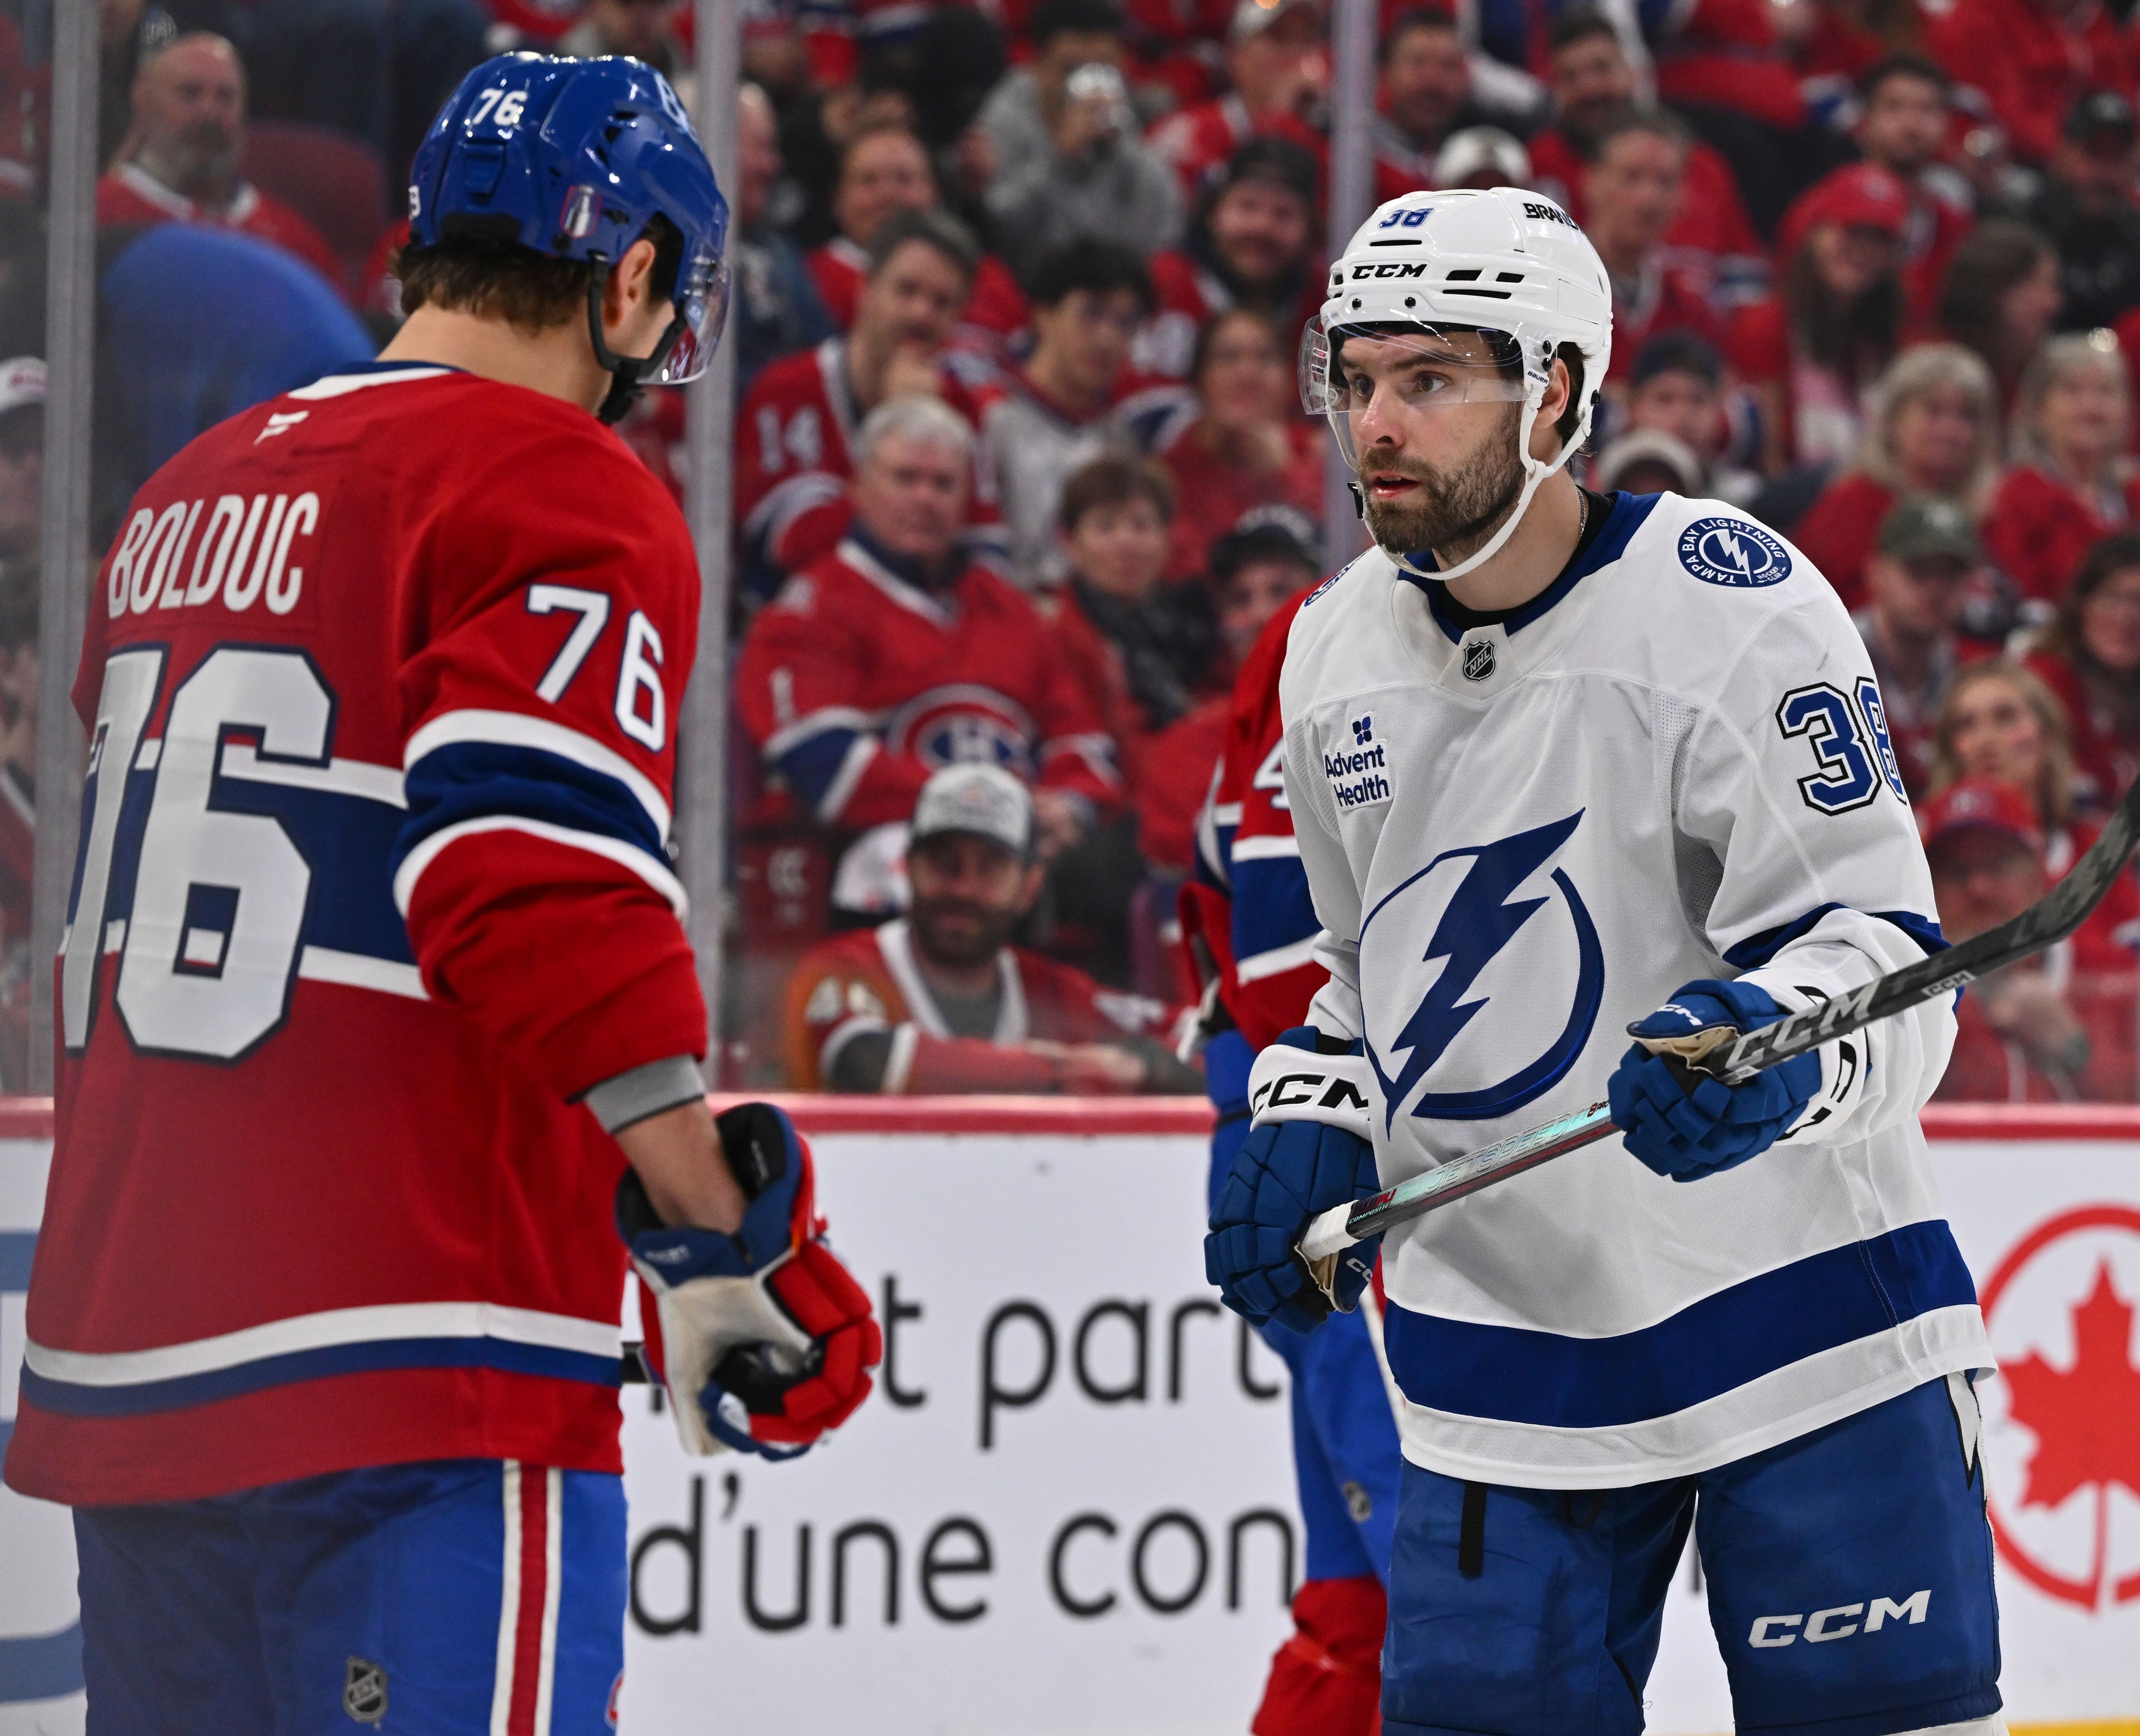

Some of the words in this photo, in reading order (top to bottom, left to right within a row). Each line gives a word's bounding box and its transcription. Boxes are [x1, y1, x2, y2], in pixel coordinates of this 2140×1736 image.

[472, 87, 528, 126] 76
[1378, 208, 1435, 229] 38
[1522, 203, 1584, 234] BRAND
[1352, 264, 1427, 279] CCM
[108, 492, 320, 619] BOLDUC
[1682, 528, 1700, 551] BAY
[1698, 519, 1786, 559] LIGHTNING
[1685, 554, 1737, 584] TAMPA
[1756, 565, 1779, 580] HOCKEY
[1767, 572, 1783, 582] CLUB
[526, 583, 666, 752] 76
[1469, 649, 1490, 675] NHL
[1325, 744, 1385, 779] Advent
[1774, 676, 1907, 817] 38
[1333, 774, 1389, 807] Health
[62, 642, 338, 1065] 76
[1725, 977, 1881, 1069] CCM
[1425, 1113, 1571, 1194] JETSPEED
[1349, 1203, 1390, 1224] COMPOSITE
[629, 1471, 993, 1637] d'une
[1748, 1589, 1932, 1648] CCM
